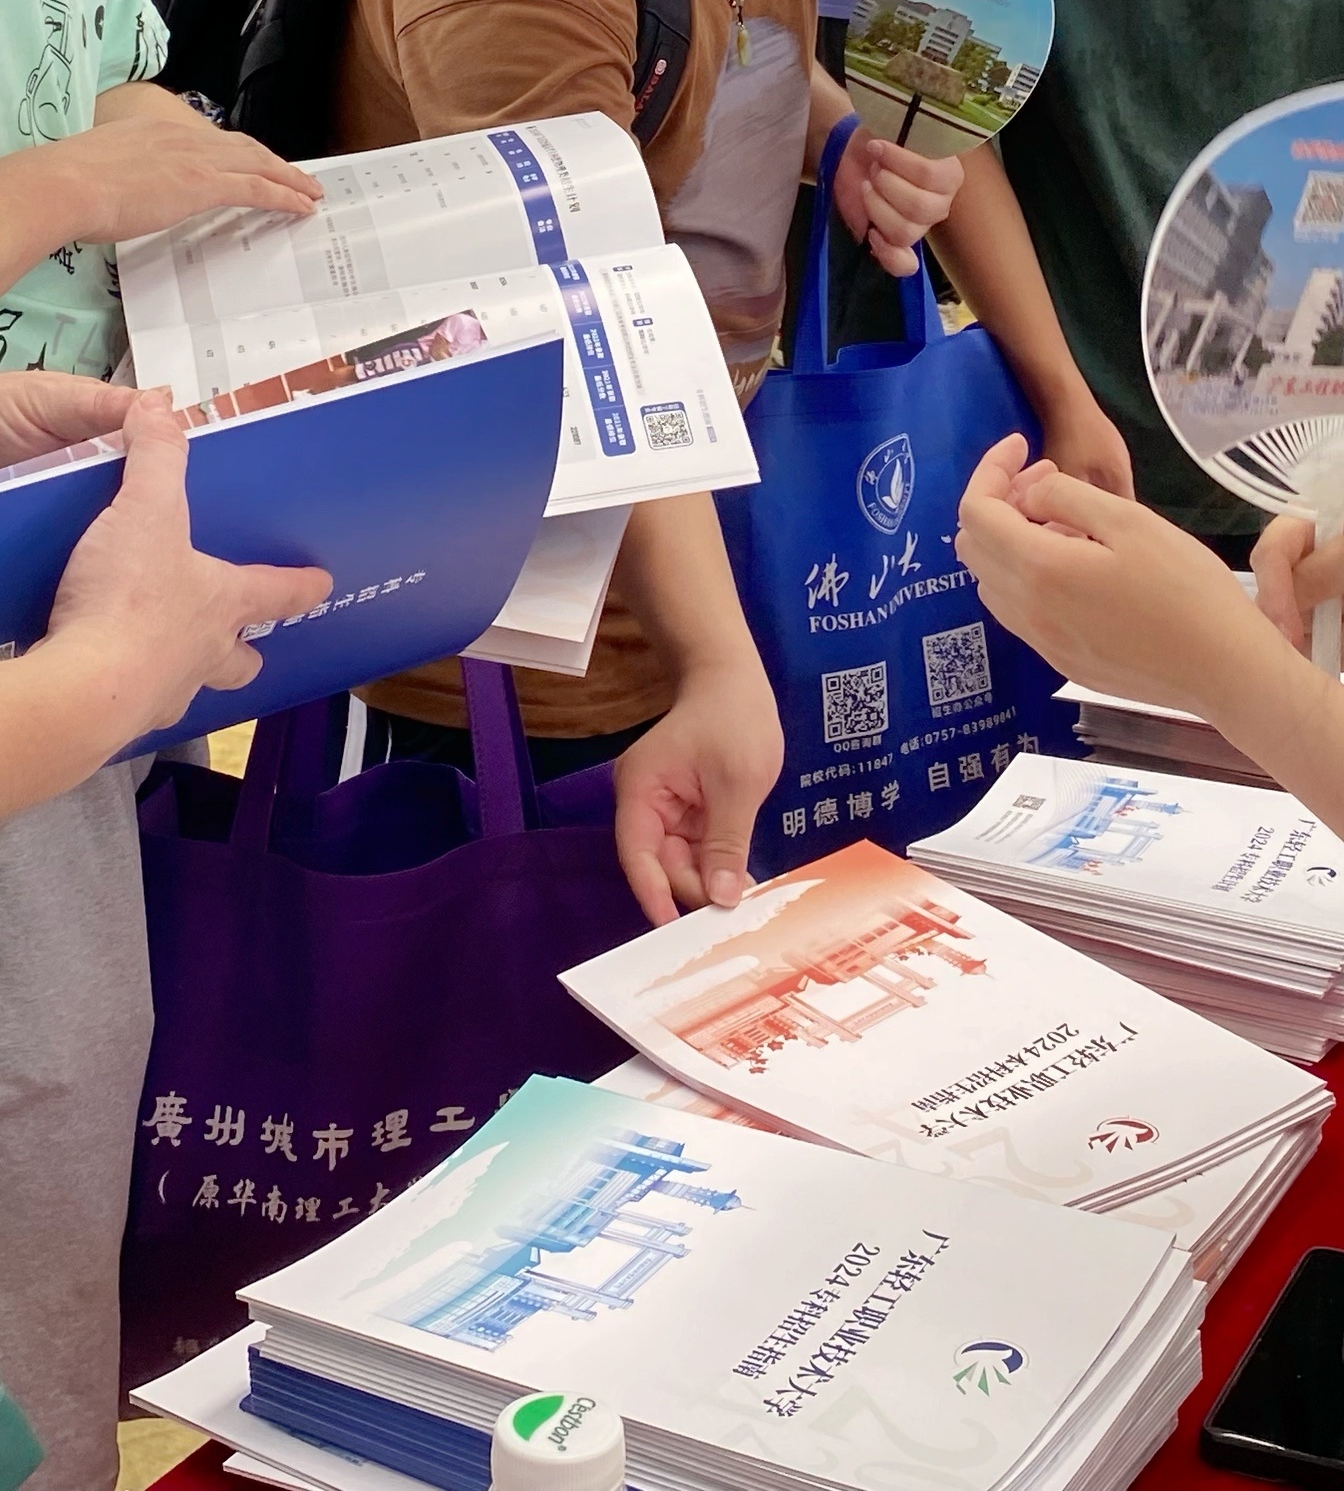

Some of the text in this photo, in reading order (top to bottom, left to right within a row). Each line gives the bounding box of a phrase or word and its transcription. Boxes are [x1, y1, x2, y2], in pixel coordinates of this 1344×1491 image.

[809, 603, 889, 633] FOSHAN
[783, 732, 1040, 838] 明德博学 自强有为
[1240, 819, 1317, 903] 广东轻工职业技术大学
[919, 1021, 1138, 1138] 广东轻工职业技术大学
[142, 1090, 518, 1171] 廣州城市理工
[158, 1170, 423, 1223] （原华南理工大
[763, 1228, 950, 1417] 广东轻工职业技术大学
